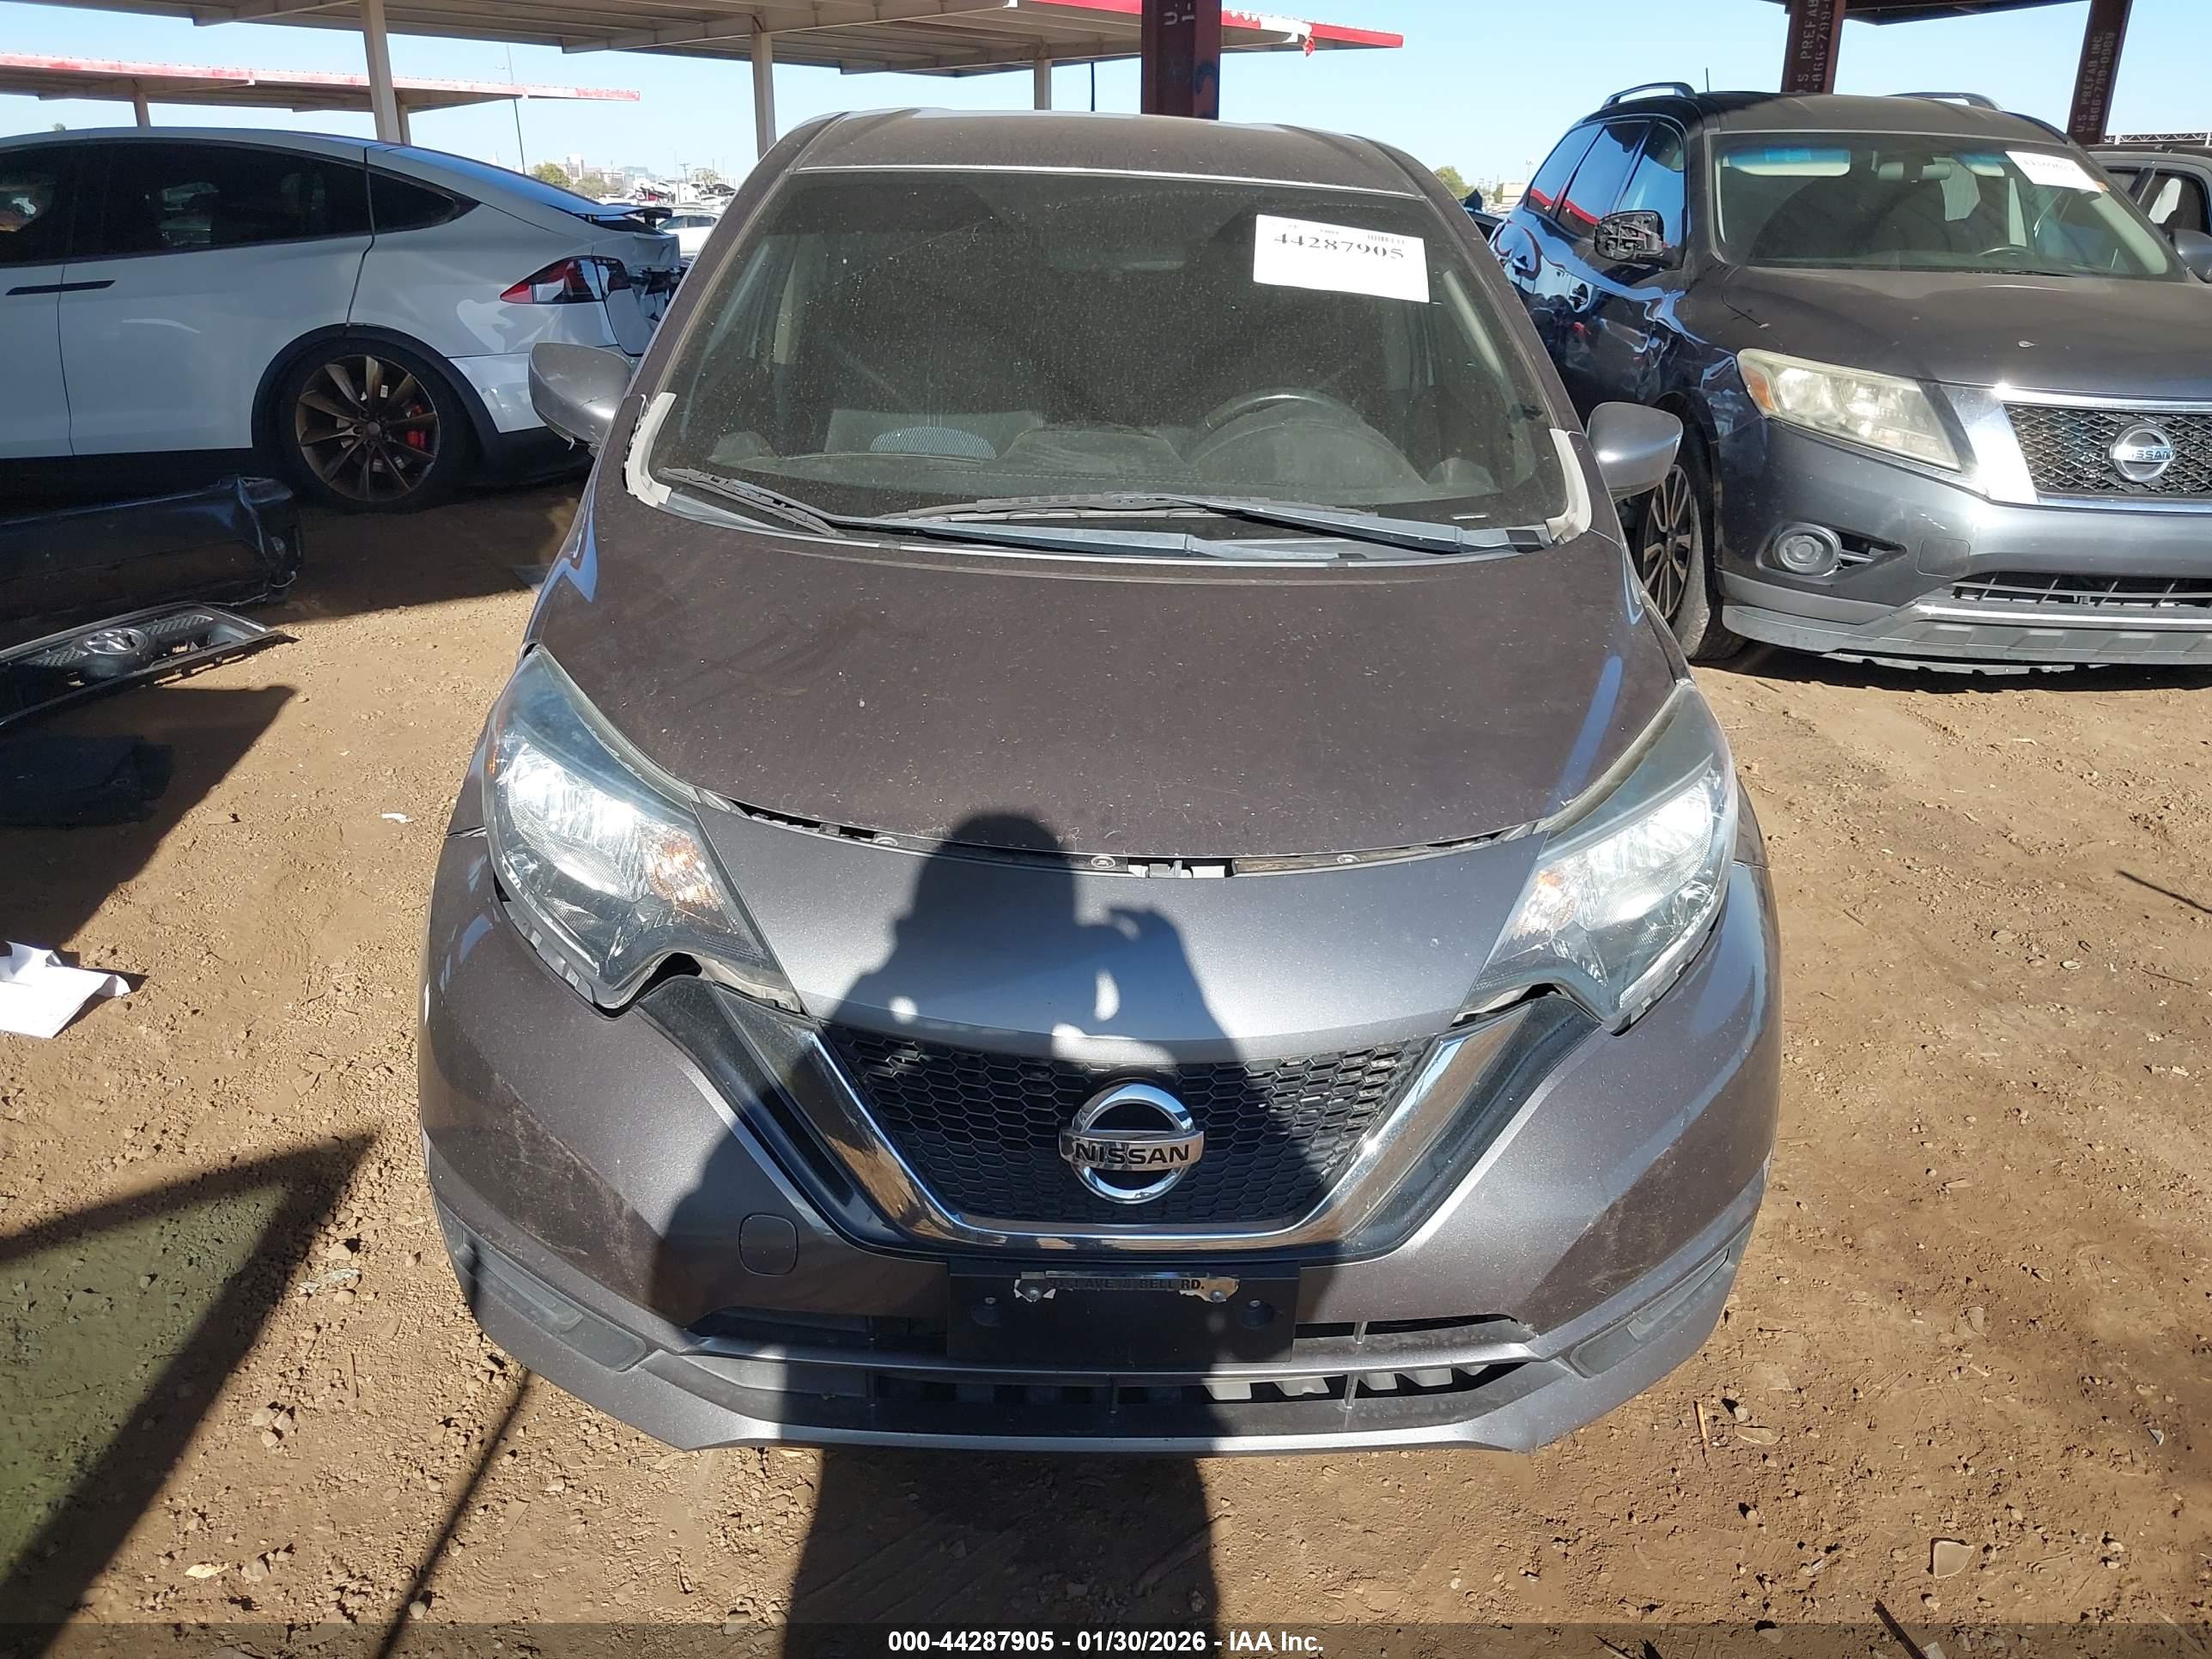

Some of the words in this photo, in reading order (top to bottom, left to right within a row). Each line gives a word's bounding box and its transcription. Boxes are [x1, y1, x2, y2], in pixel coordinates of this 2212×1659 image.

[1800, 0, 1819, 59] PREFAB
[2075, 112, 2087, 132] U.S.
[2081, 60, 2098, 105] PREFAB
[1274, 233, 1404, 259] 44287905
[2130, 450, 2172, 460] SSAN
[1076, 1143, 1189, 1164] NISSAN
[1140, 1279, 1175, 1289] BELL
[1181, 1279, 1205, 1289] RD.
